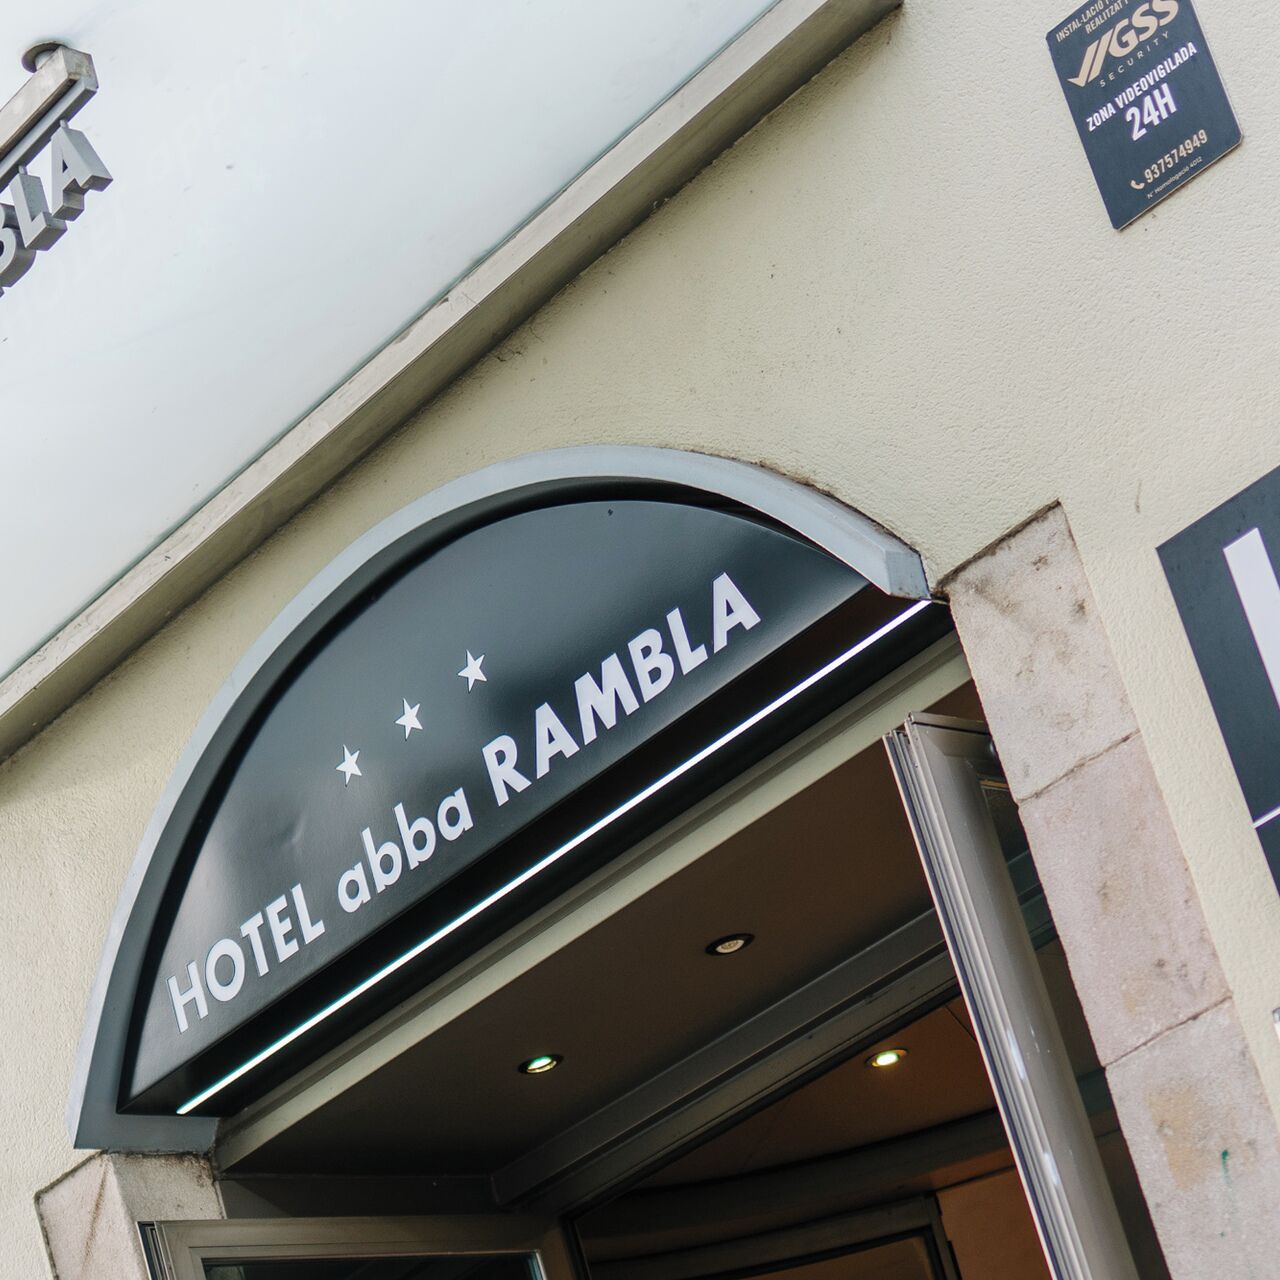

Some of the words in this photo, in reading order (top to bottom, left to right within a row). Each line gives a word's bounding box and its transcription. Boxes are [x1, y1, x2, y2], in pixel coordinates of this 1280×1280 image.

[1085, 1, 1123, 34] REALITZAT
[1086, 104, 1116, 132] ZONA
[1115, 42, 1197, 109] VIDEOVIGILADA
[1099, 31, 1170, 88] SECURITY
[1124, 83, 1177, 142] 24H
[1144, 129, 1208, 184] 937574949
[167, 884, 325, 1033] HOTEL
[337, 787, 473, 913] abba
[481, 572, 761, 806] RAMBLA
